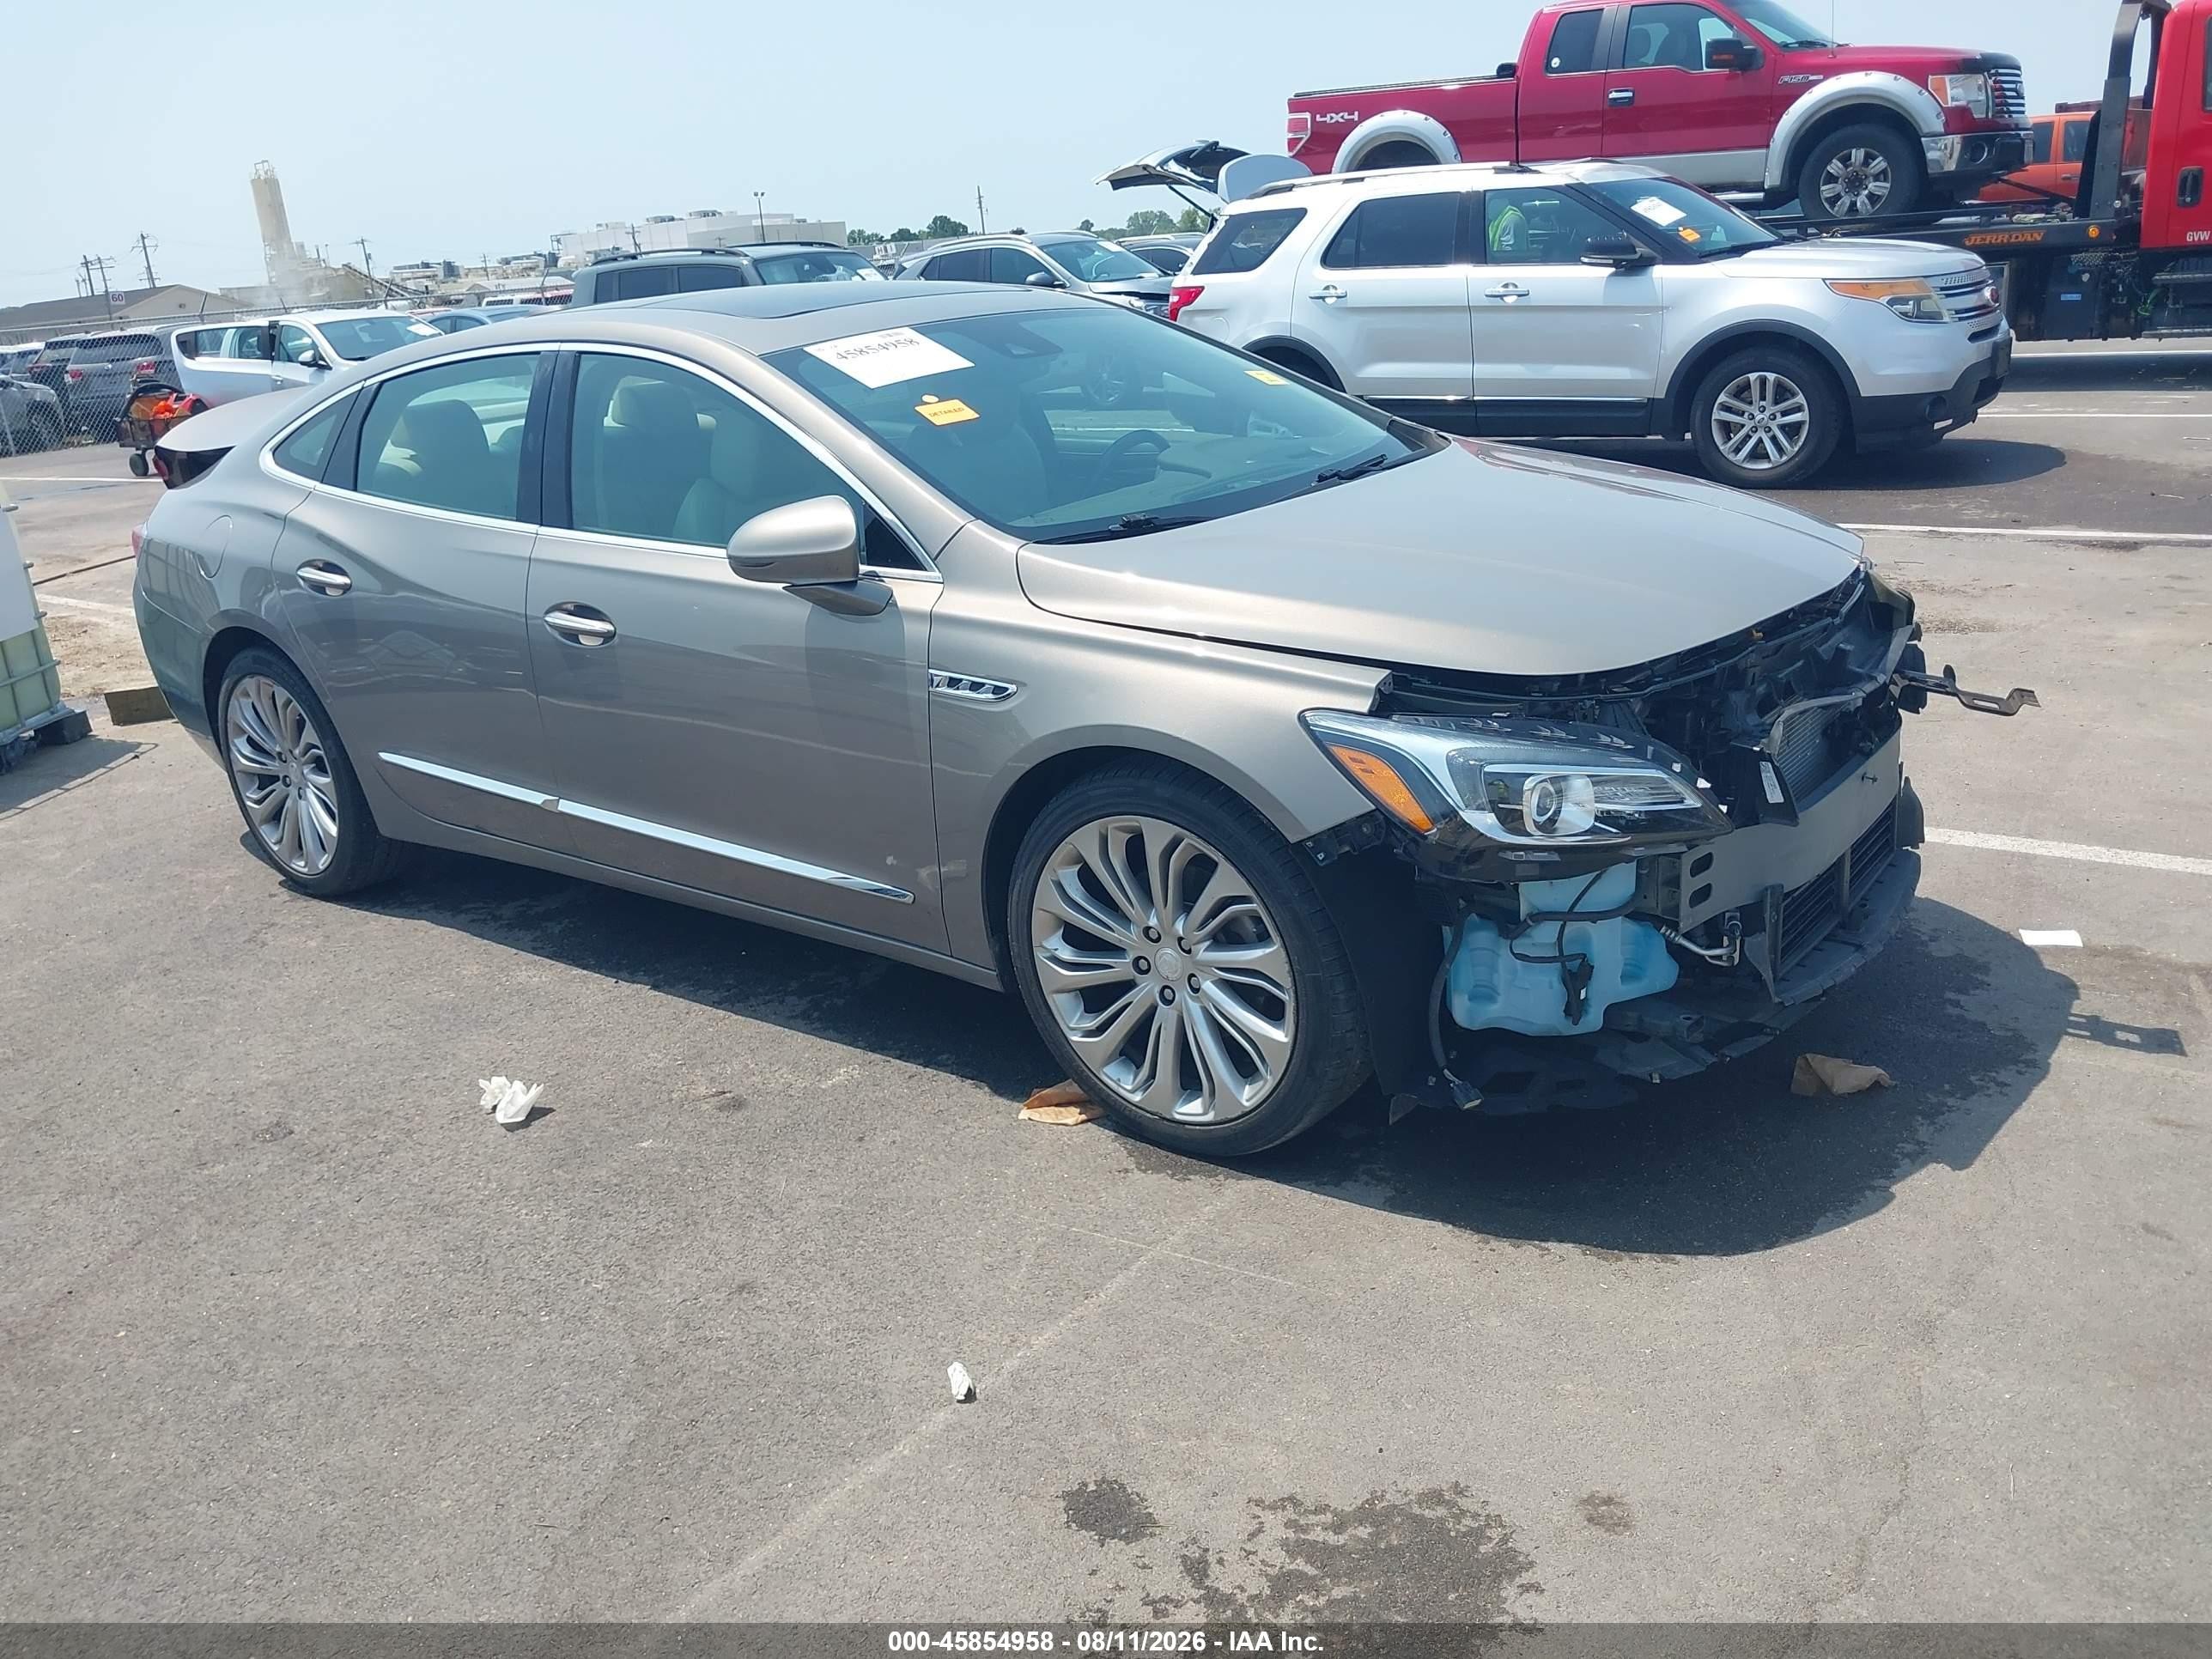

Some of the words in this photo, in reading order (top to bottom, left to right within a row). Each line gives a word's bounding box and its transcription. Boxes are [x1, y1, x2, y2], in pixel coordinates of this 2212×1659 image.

[2186, 230, 2211, 241] GVW
[112, 294, 124, 302] 60
[836, 337, 921, 361] 45854958
